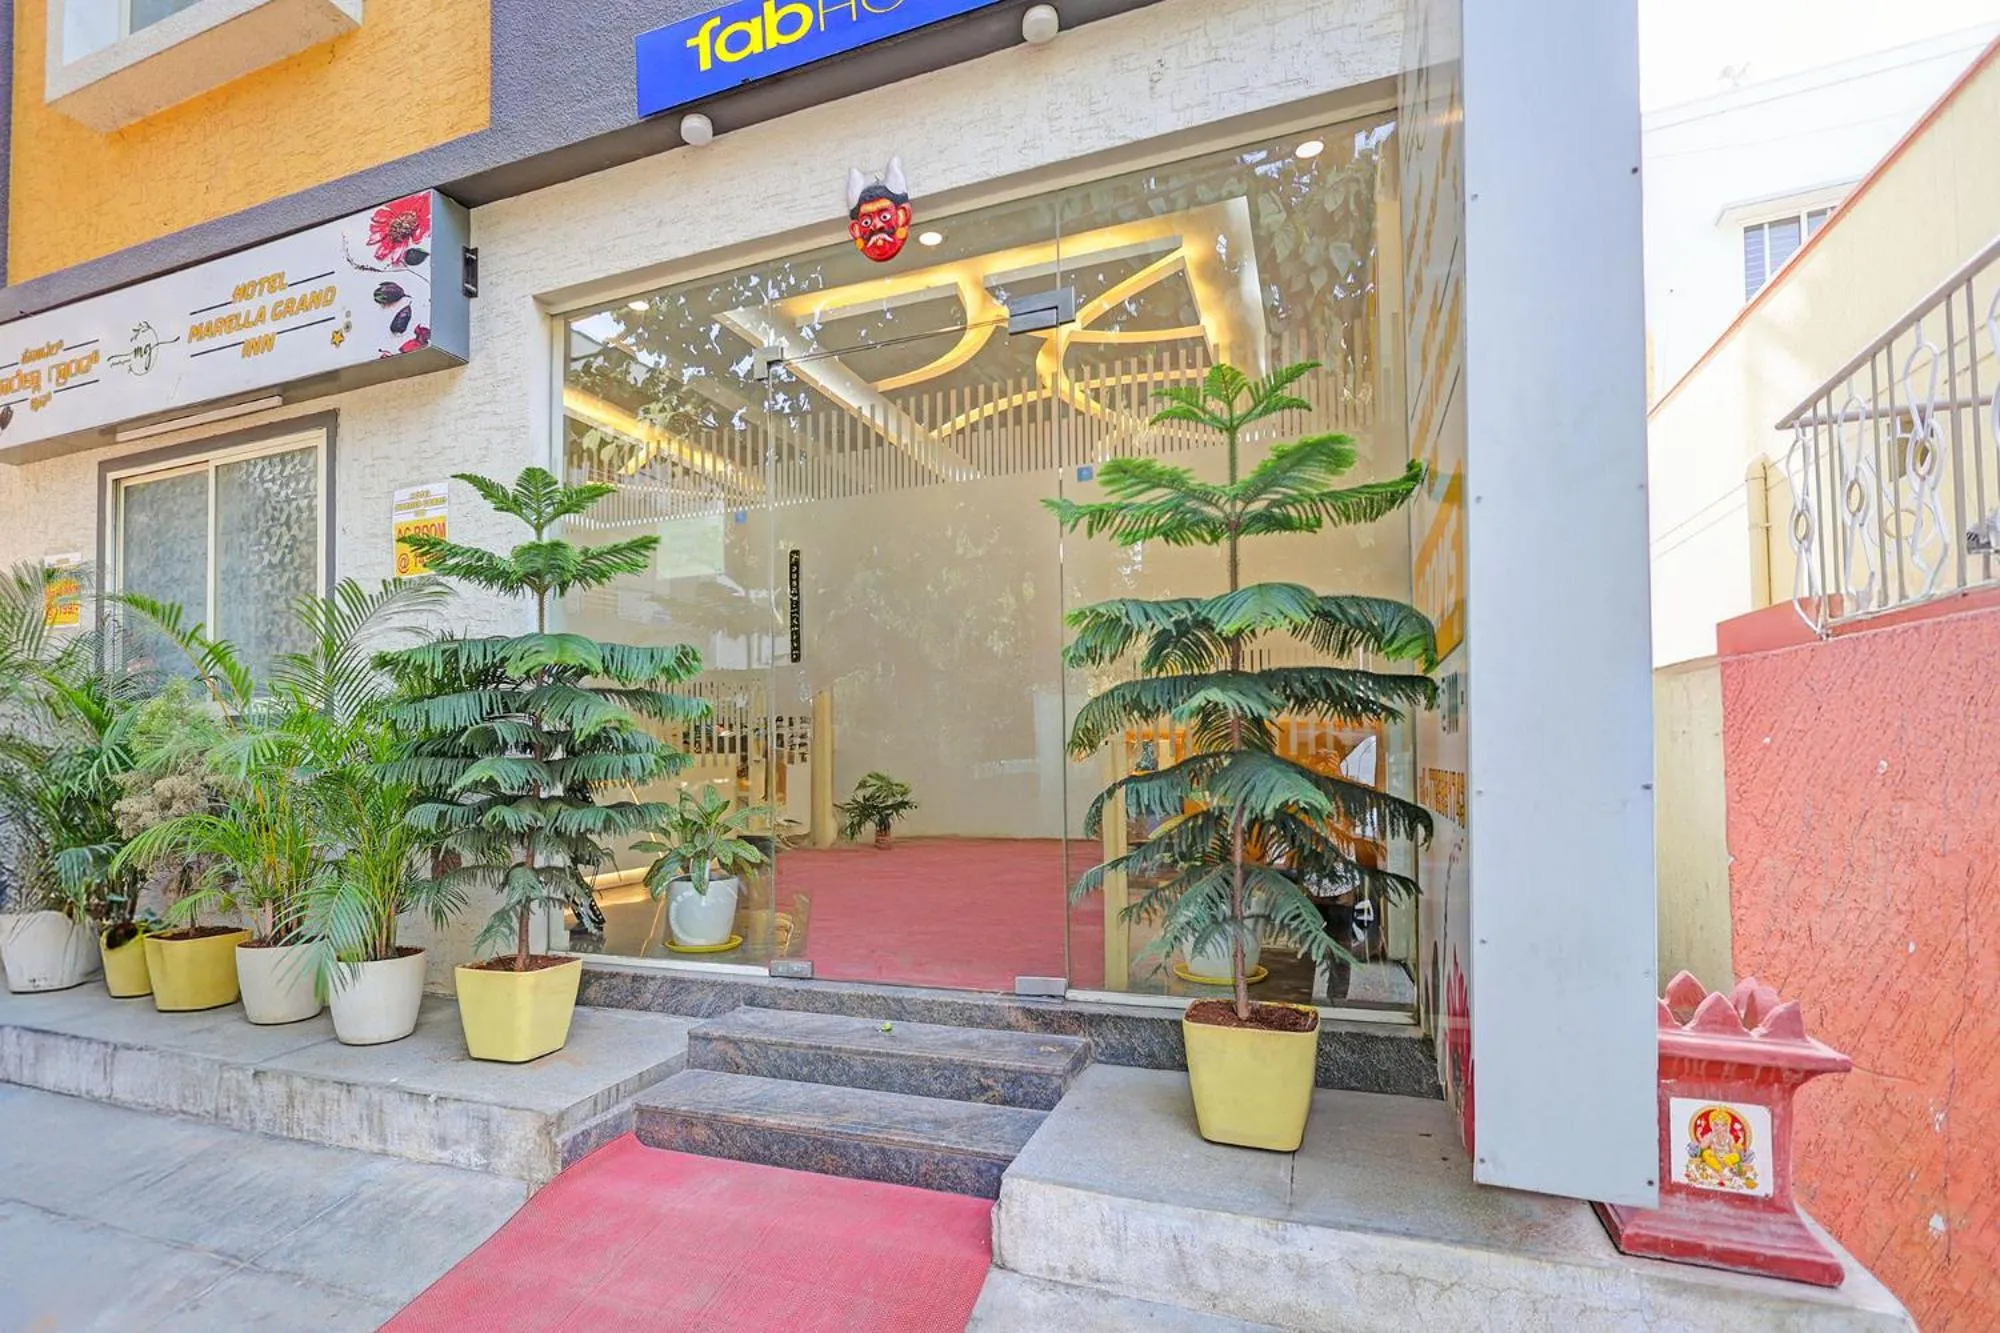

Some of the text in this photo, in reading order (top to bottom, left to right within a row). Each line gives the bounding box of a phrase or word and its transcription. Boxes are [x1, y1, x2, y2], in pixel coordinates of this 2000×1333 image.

[231, 271, 288, 303] HOTEL
[188, 285, 337, 343] MARELLA GRAND
[241, 332, 277, 359] INN
